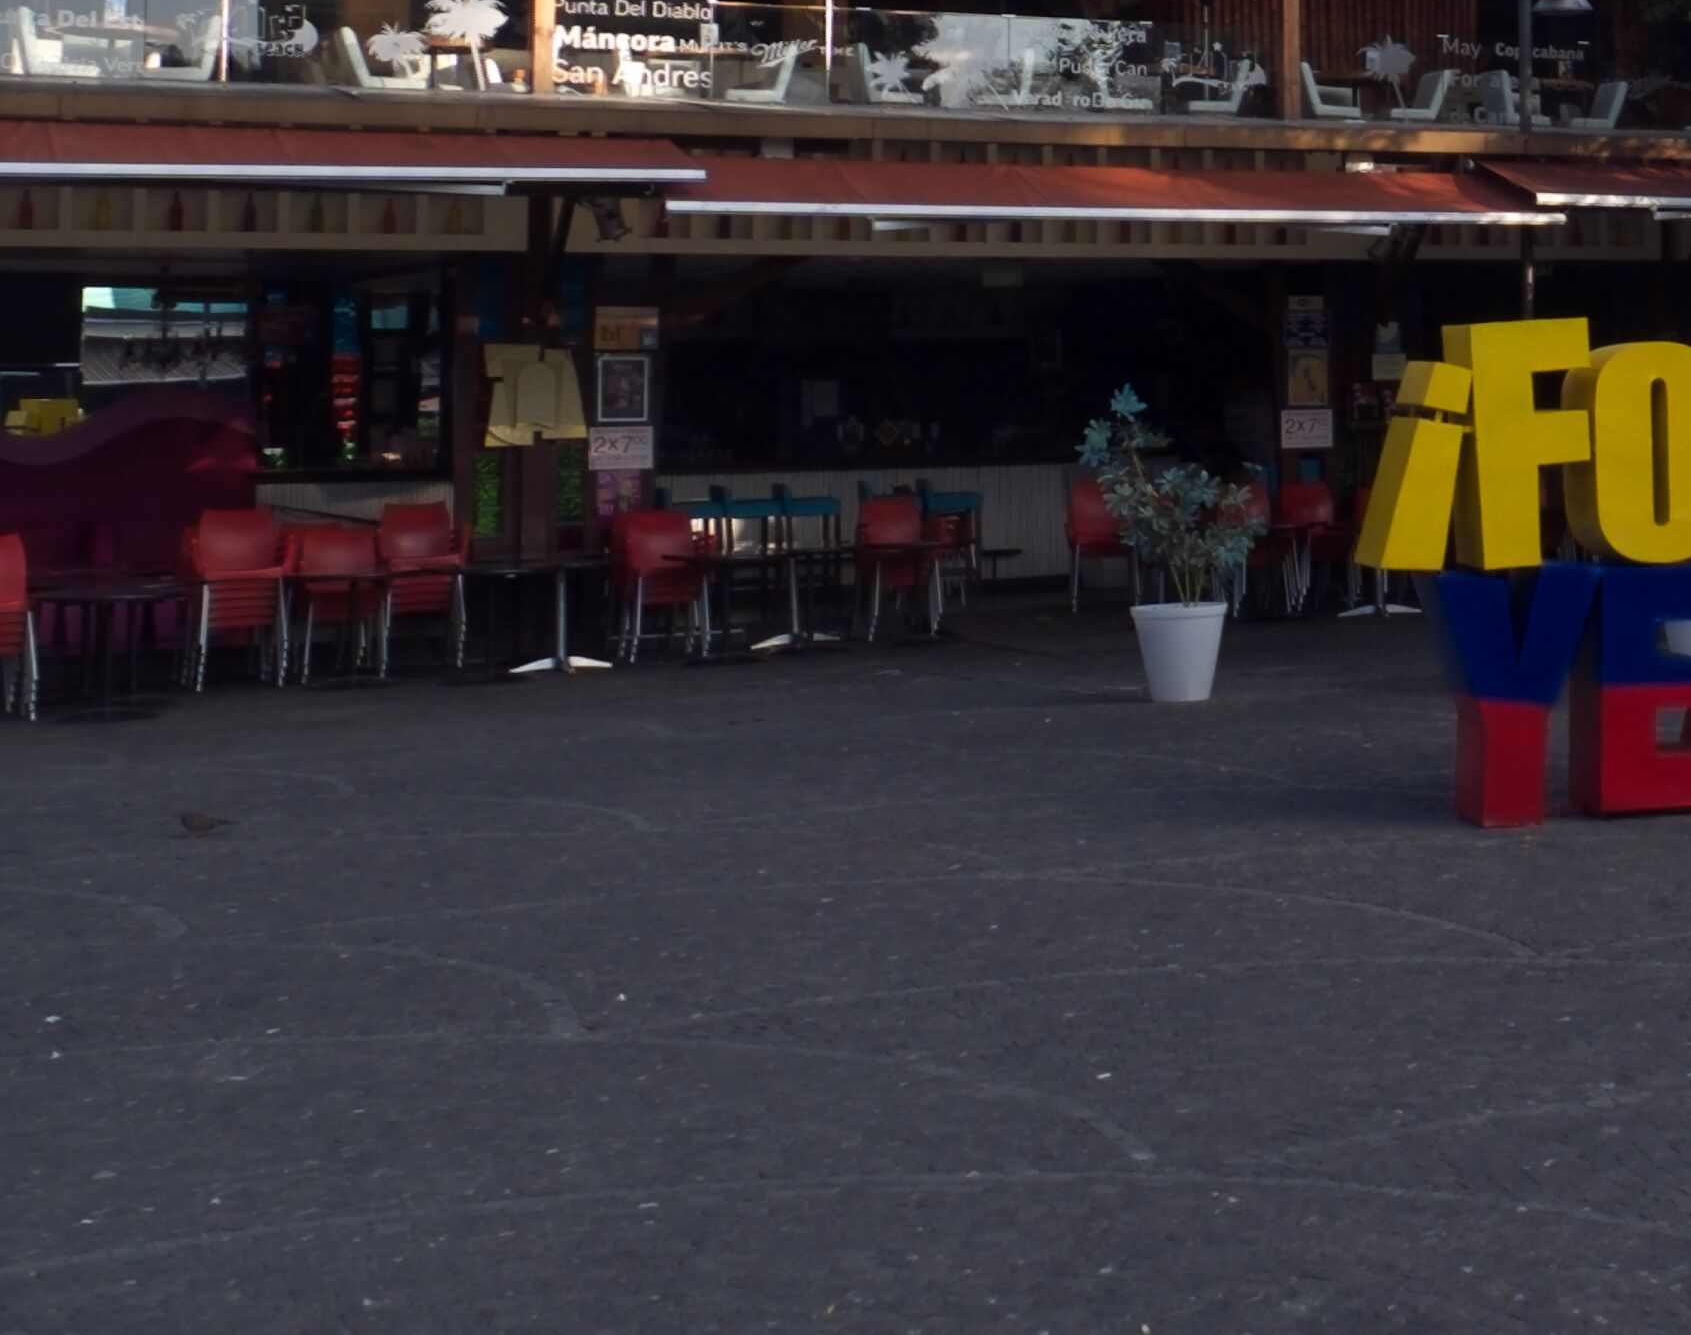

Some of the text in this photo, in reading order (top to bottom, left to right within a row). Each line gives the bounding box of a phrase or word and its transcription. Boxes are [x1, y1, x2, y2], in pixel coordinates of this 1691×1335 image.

[57, 9, 97, 28] Del
[614, 0, 646, 16] Del
[652, 1, 713, 21] Diablo
[552, 24, 676, 52] Máncora
[1442, 36, 1483, 59] May
[552, 58, 606, 85] San
